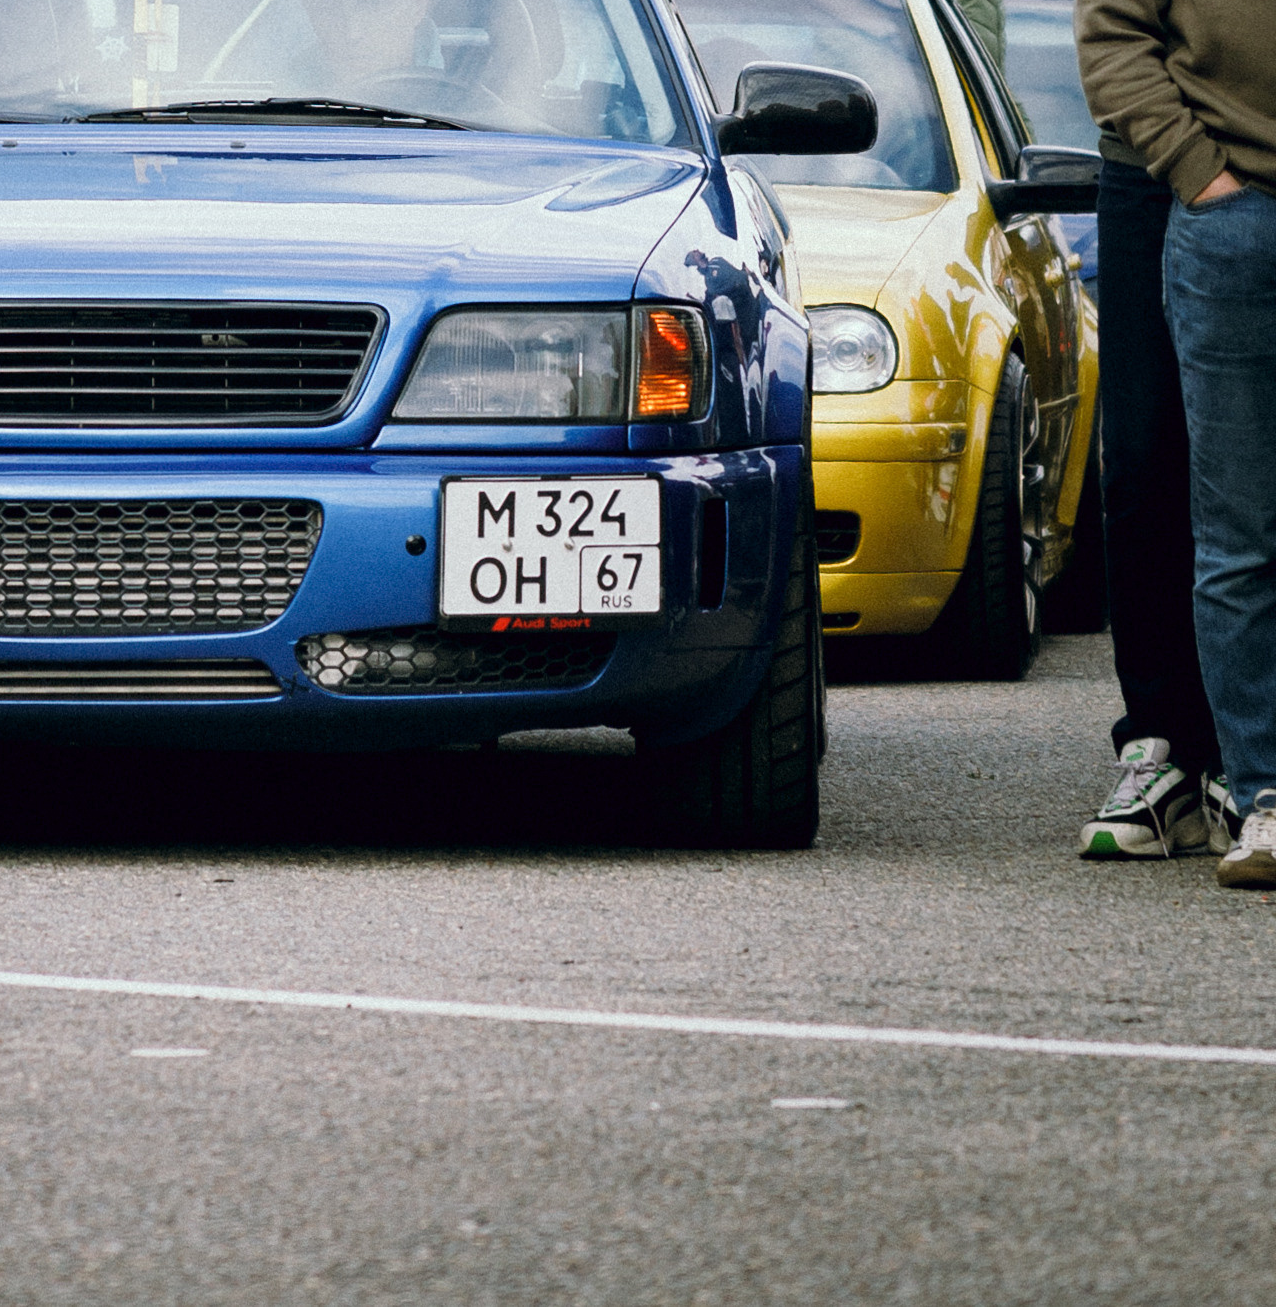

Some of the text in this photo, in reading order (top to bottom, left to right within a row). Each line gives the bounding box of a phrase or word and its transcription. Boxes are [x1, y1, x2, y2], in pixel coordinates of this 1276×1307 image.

[478, 489, 626, 538] М 324
[470, 556, 547, 604] ОН
[597, 553, 643, 592] 67
[601, 595, 632, 609] RUS
[512, 617, 591, 630] Audi Sport
